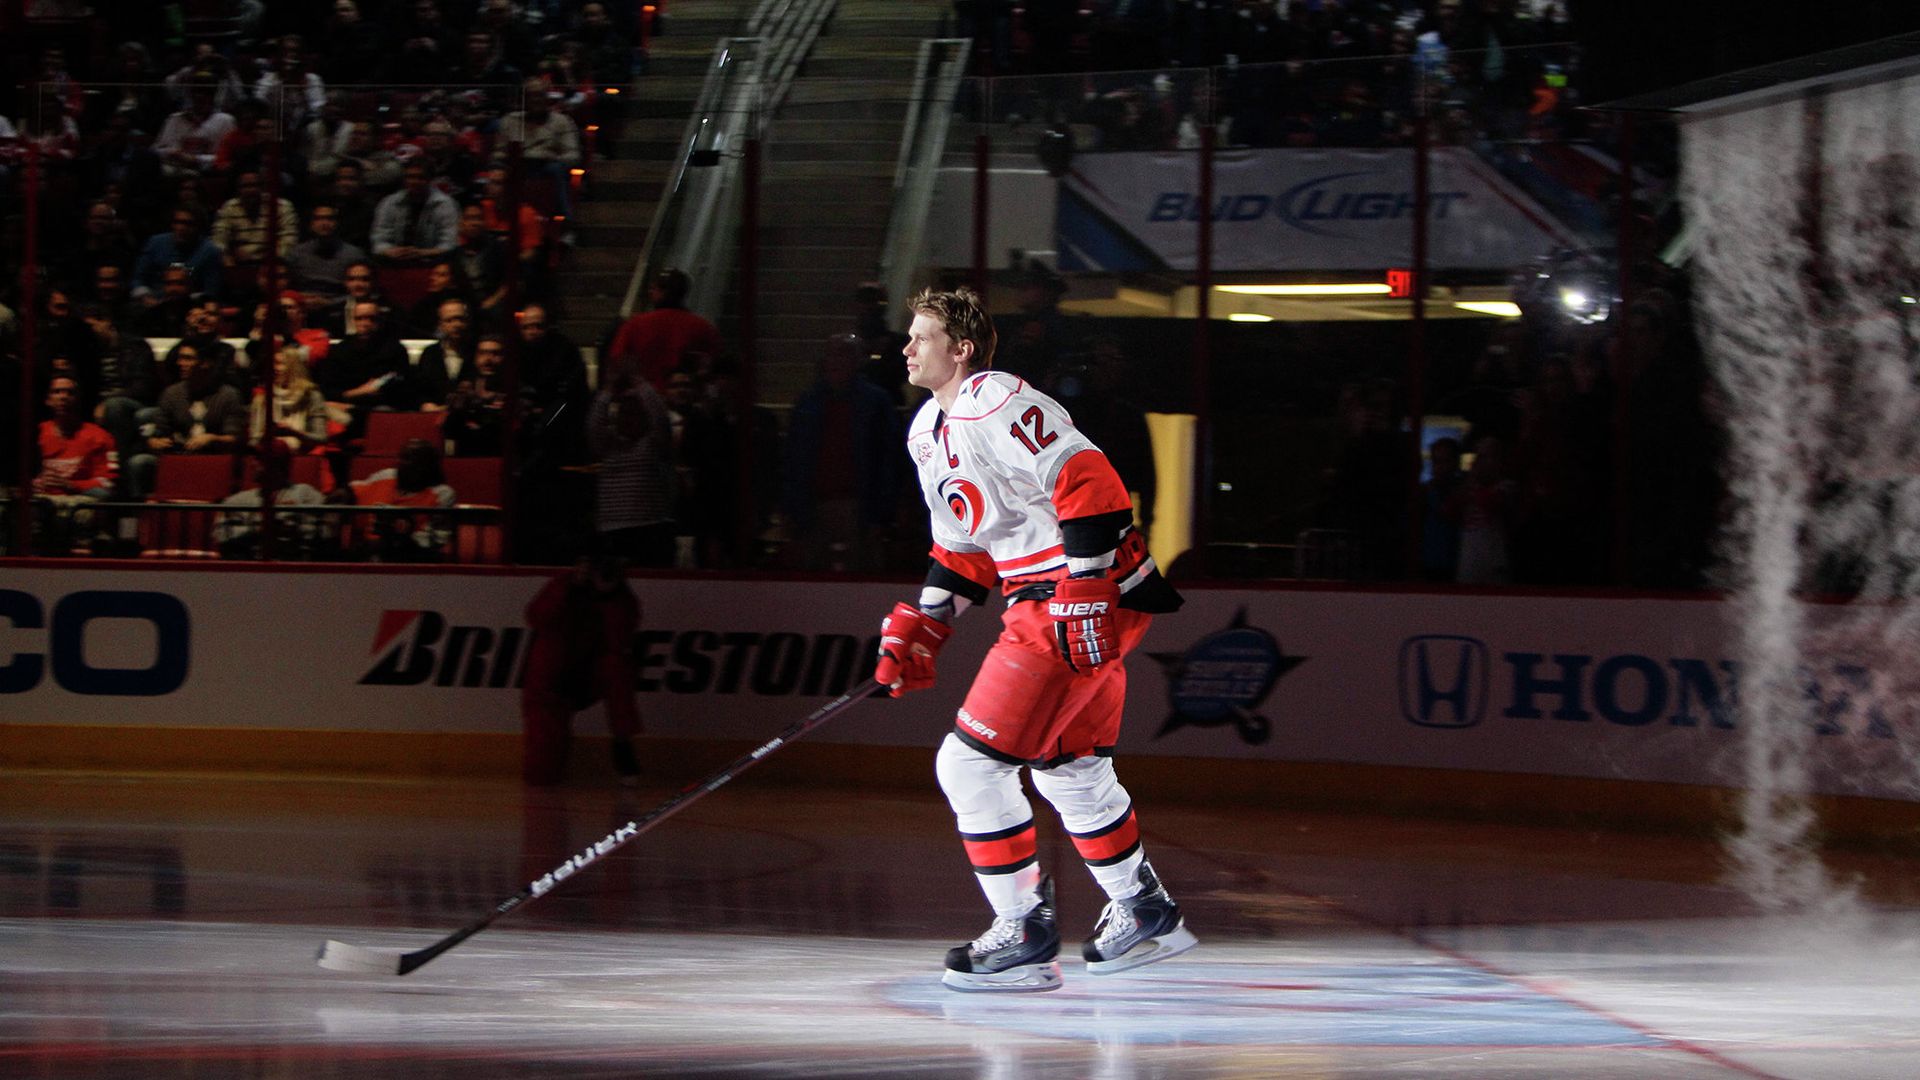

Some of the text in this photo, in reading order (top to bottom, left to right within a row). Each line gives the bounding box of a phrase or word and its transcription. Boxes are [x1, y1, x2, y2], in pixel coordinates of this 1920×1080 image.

[1148, 190, 1468, 222] BUD LIGHT
[943, 424, 960, 469] C
[1010, 405, 1059, 456] 12
[1049, 601, 1109, 617] AUER
[357, 610, 892, 699] BRIESTON
[1503, 652, 1897, 739] HON
[957, 707, 998, 740] AUER
[531, 821, 638, 898] BAUER
